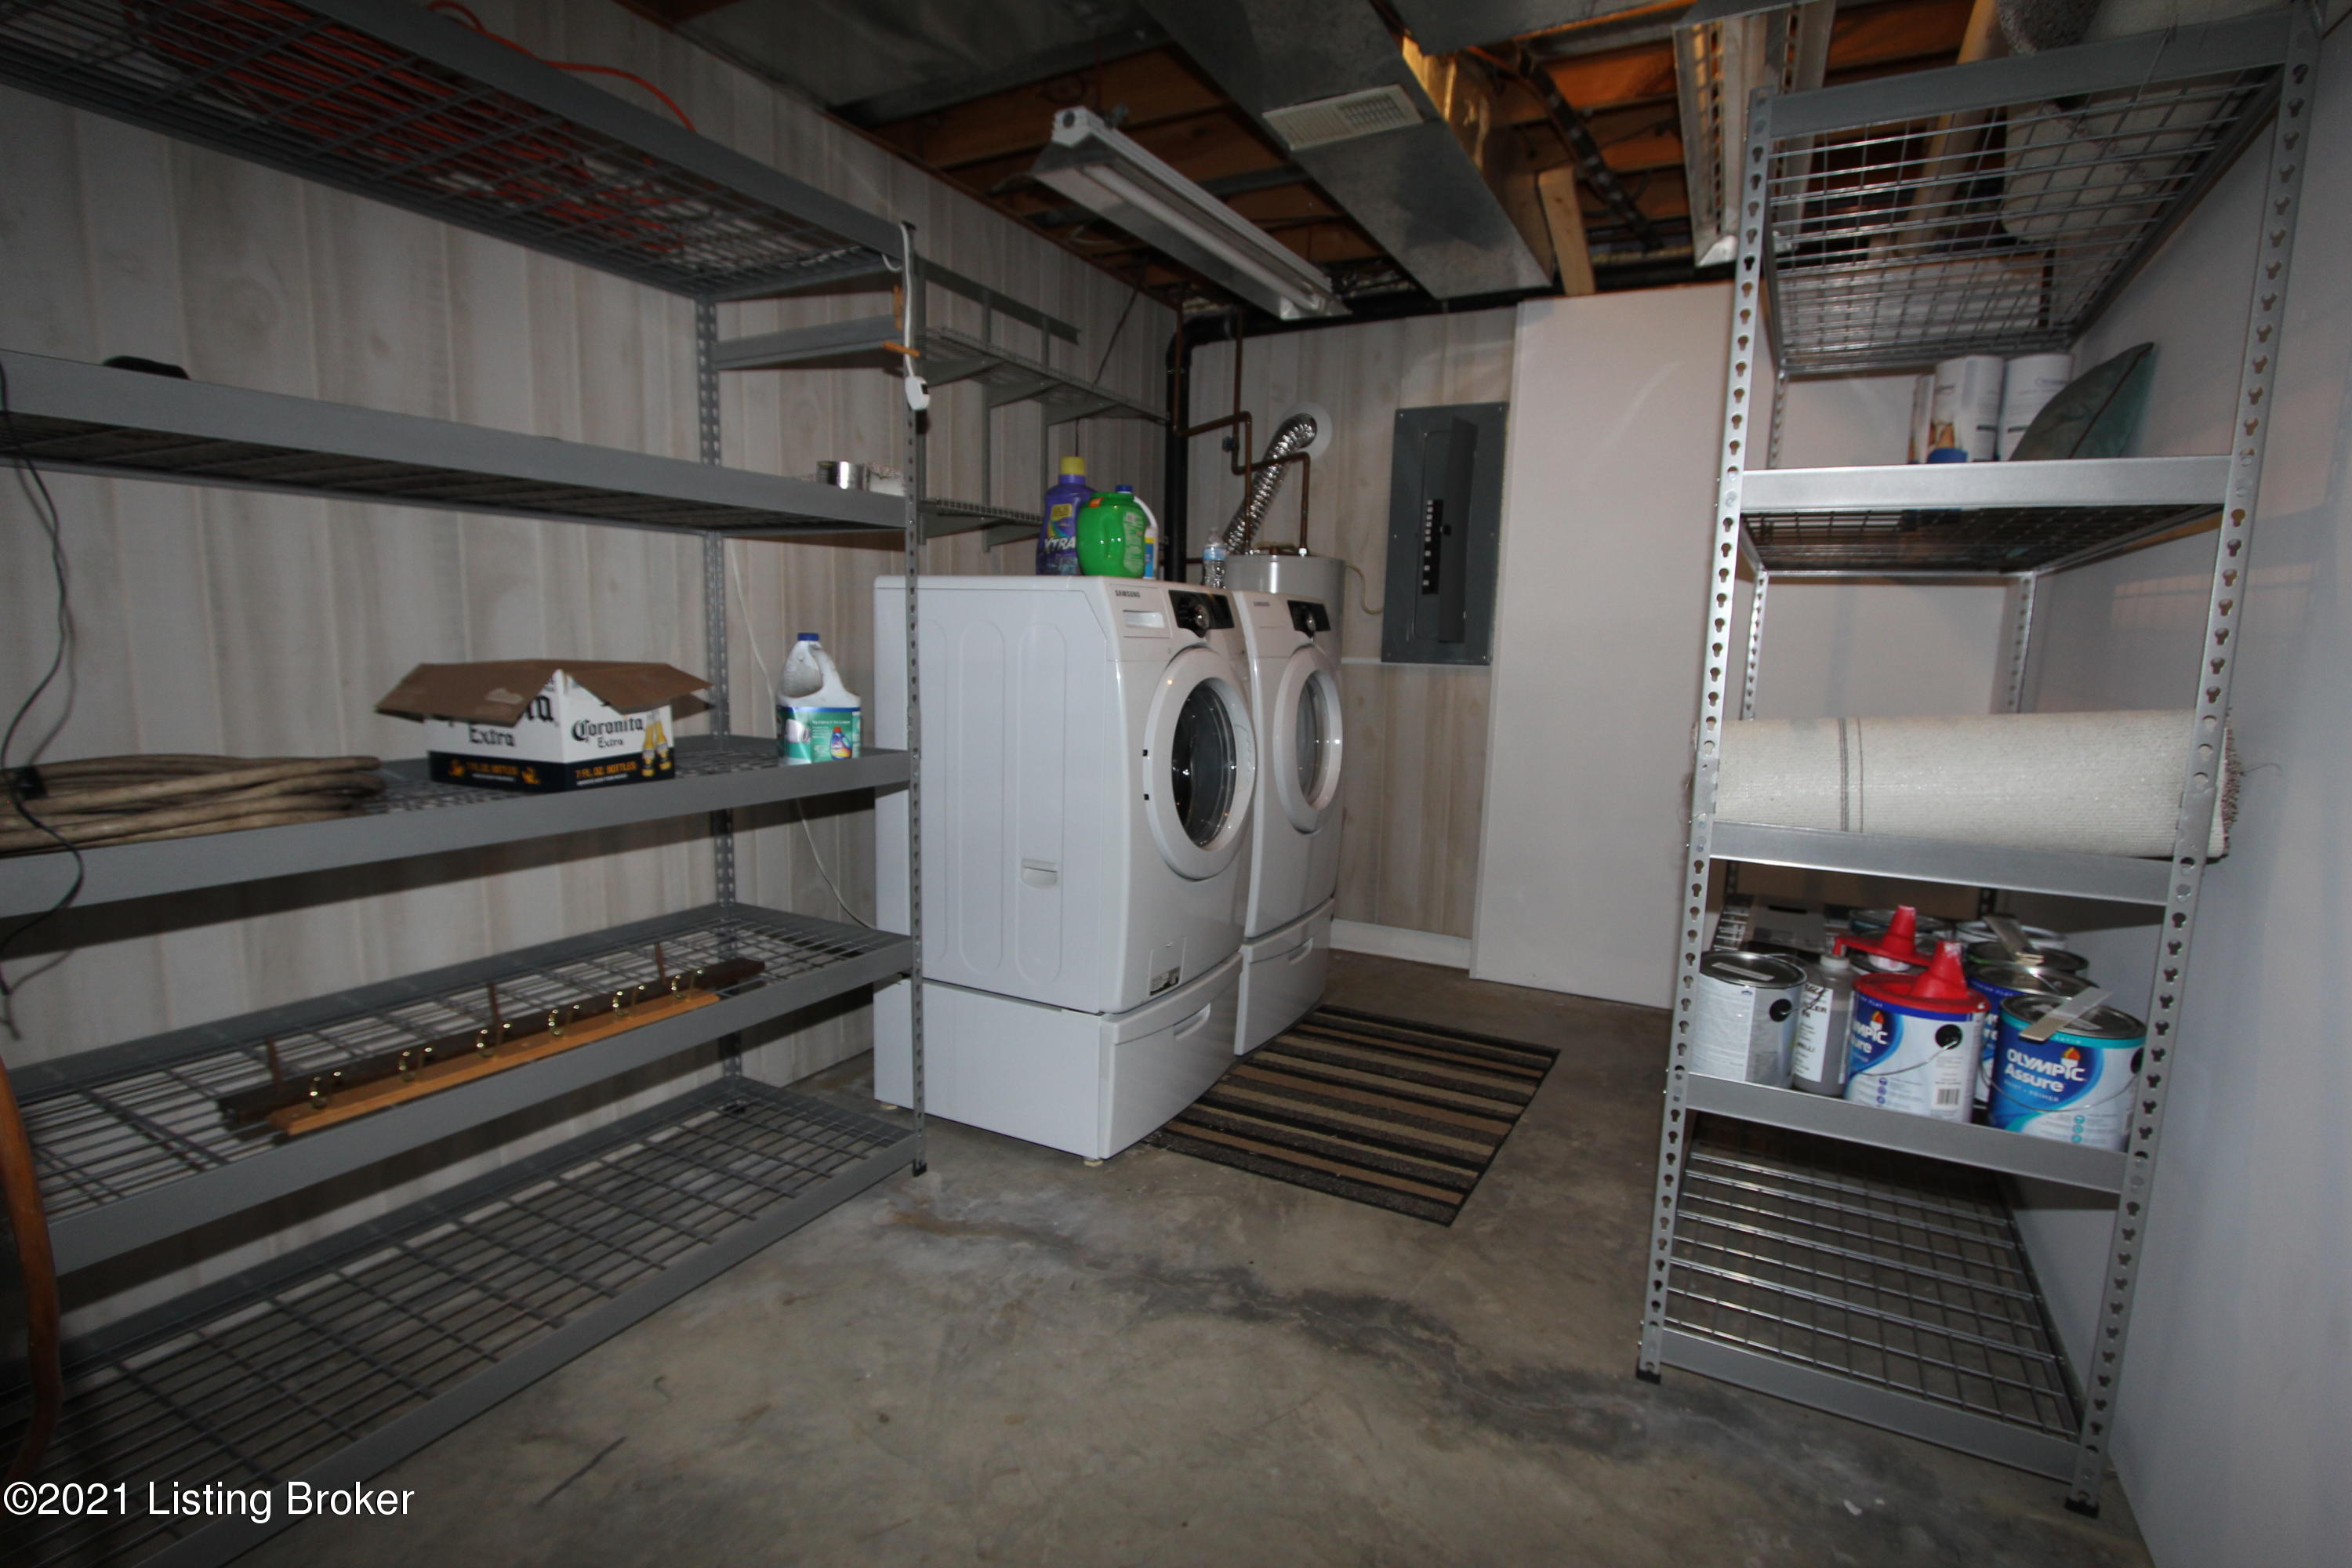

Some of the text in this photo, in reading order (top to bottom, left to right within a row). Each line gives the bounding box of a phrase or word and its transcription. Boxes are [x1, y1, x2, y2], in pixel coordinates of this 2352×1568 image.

[1115, 590, 1141, 598] SAMSUNG
[469, 727, 515, 746] Extra
[572, 717, 644, 742] Coronita
[597, 737, 624, 748] Extra
[2006, 1048, 2087, 1082] OLYMPIC
[2004, 1063, 2064, 1093] Assure
